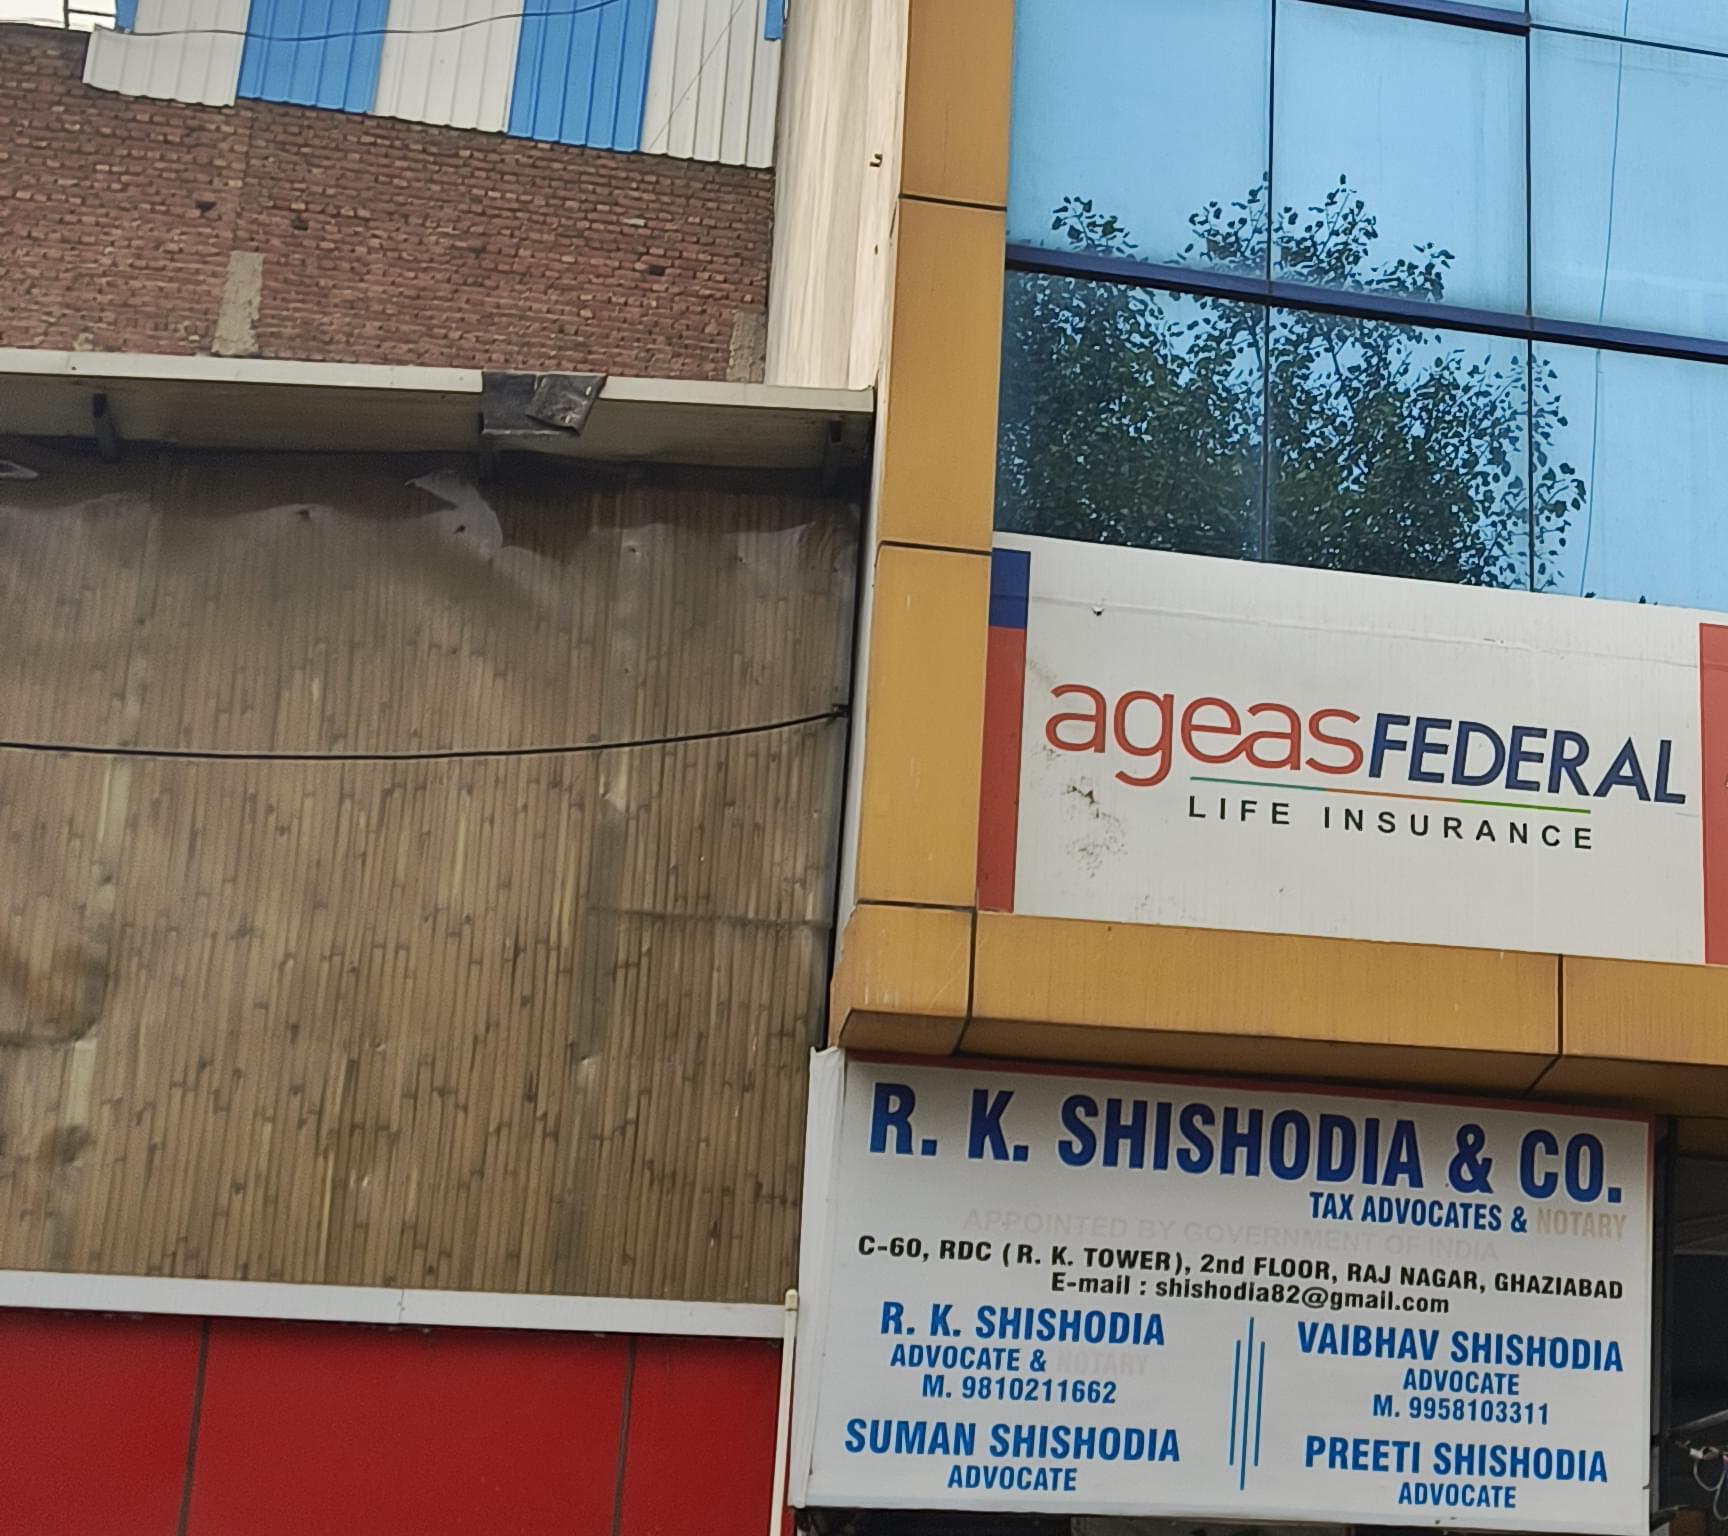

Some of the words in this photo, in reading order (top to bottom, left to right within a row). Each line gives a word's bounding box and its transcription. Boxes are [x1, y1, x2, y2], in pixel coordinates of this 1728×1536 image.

[1367, 711, 1689, 806] FEDERAL
[1187, 794, 1291, 827] LIFE
[1322, 805, 1593, 851] INSURANCE
[869, 1081, 938, 1157] R.
[967, 1087, 1029, 1162] K.
[1057, 1093, 1424, 1189] SHISHODIA
[1448, 1122, 1494, 1194] &
[1519, 1128, 1622, 1204] CO.
[961, 1208, 1128, 1238] APPOINTED
[1136, 1219, 1176, 1242] BY
[1183, 1221, 1372, 1253] GOVERNMENT
[1384, 1232, 1421, 1257] OF
[1428, 1236, 1498, 1262] INDIA
[1309, 1191, 1353, 1221] TAX
[1361, 1195, 1501, 1232] ADVOCATES
[1510, 1205, 1528, 1234] &
[1536, 1207, 1627, 1241] NOTARY
[857, 1234, 929, 1263] C-60,
[939, 1239, 992, 1262] RDC
[1051, 1246, 1074, 1267] K.
[1083, 1247, 1191, 1276] TOWER),
[1199, 1254, 1244, 1275] 2nd
[1254, 1256, 1337, 1284] FLOOR,
[1347, 1263, 1391, 1285] RAJ
[1400, 1267, 1486, 1294] NAGAR,
[1494, 1272, 1623, 1300] GHAZIABAD
[1051, 1272, 1130, 1296] E-mail
[1155, 1279, 1449, 1314] shishodia82@gmail.com
[880, 1301, 915, 1335] R.
[929, 1303, 961, 1338] K.
[975, 1305, 1165, 1346] SHISHODIA
[1297, 1320, 1440, 1361] VAIBHAV
[1450, 1330, 1624, 1372] SHISHODIA
[890, 1343, 1021, 1372] ADVOCATE
[1029, 1349, 1047, 1373] &
[1055, 1350, 1149, 1378] NOTARY
[1402, 1367, 1520, 1396] ADVOCATE
[921, 1374, 951, 1399] M.
[962, 1376, 1117, 1405] 9810211662
[1372, 1394, 1400, 1419] M.
[1408, 1396, 1549, 1426] 9958103311
[845, 1418, 977, 1457] SUMAN
[989, 1423, 1180, 1463] SHISHODIA
[1304, 1434, 1422, 1474] PREETI
[1432, 1441, 1608, 1483] SHISHODIA
[947, 1464, 1078, 1492] ADVOCATE
[1398, 1481, 1517, 1509] ADVOCATE
